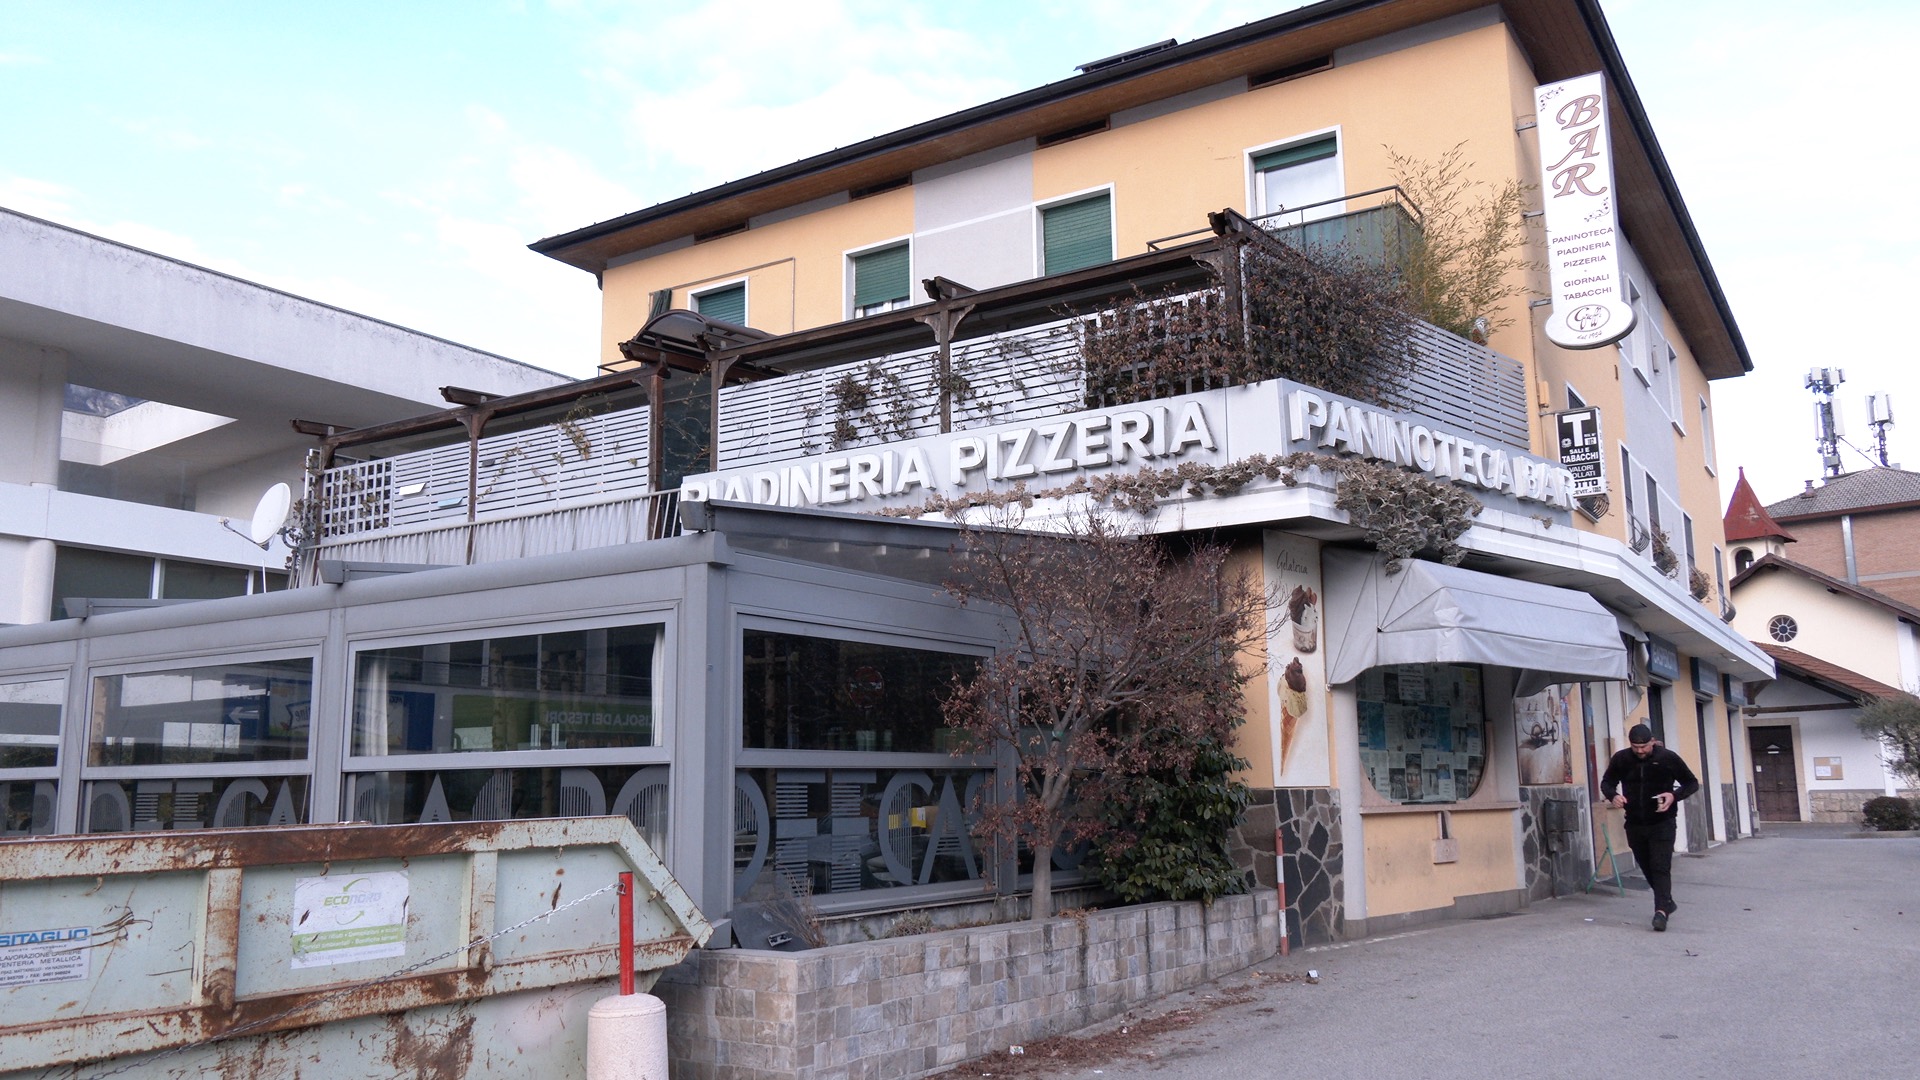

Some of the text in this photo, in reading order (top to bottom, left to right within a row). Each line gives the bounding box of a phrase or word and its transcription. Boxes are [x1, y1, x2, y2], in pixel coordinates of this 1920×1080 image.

[1546, 94, 1607, 198] BAR
[1552, 227, 1614, 244] PANINOTECA
[1557, 241, 1610, 256] PIADINERIA
[1564, 255, 1606, 268] PIZZERIA
[1564, 274, 1609, 287] GIORNALI
[1564, 287, 1612, 300] TABACCHI
[1562, 412, 1591, 447] T
[681, 401, 1217, 508] PIADINERIA PIZZERIA
[1288, 389, 1515, 494] PANINOTECA
[1511, 455, 1578, 511] BAR
[1562, 452, 1599, 463] TABACCHI
[1569, 465, 1594, 473] VALORI
[40, 956, 81, 964] METALLICA
